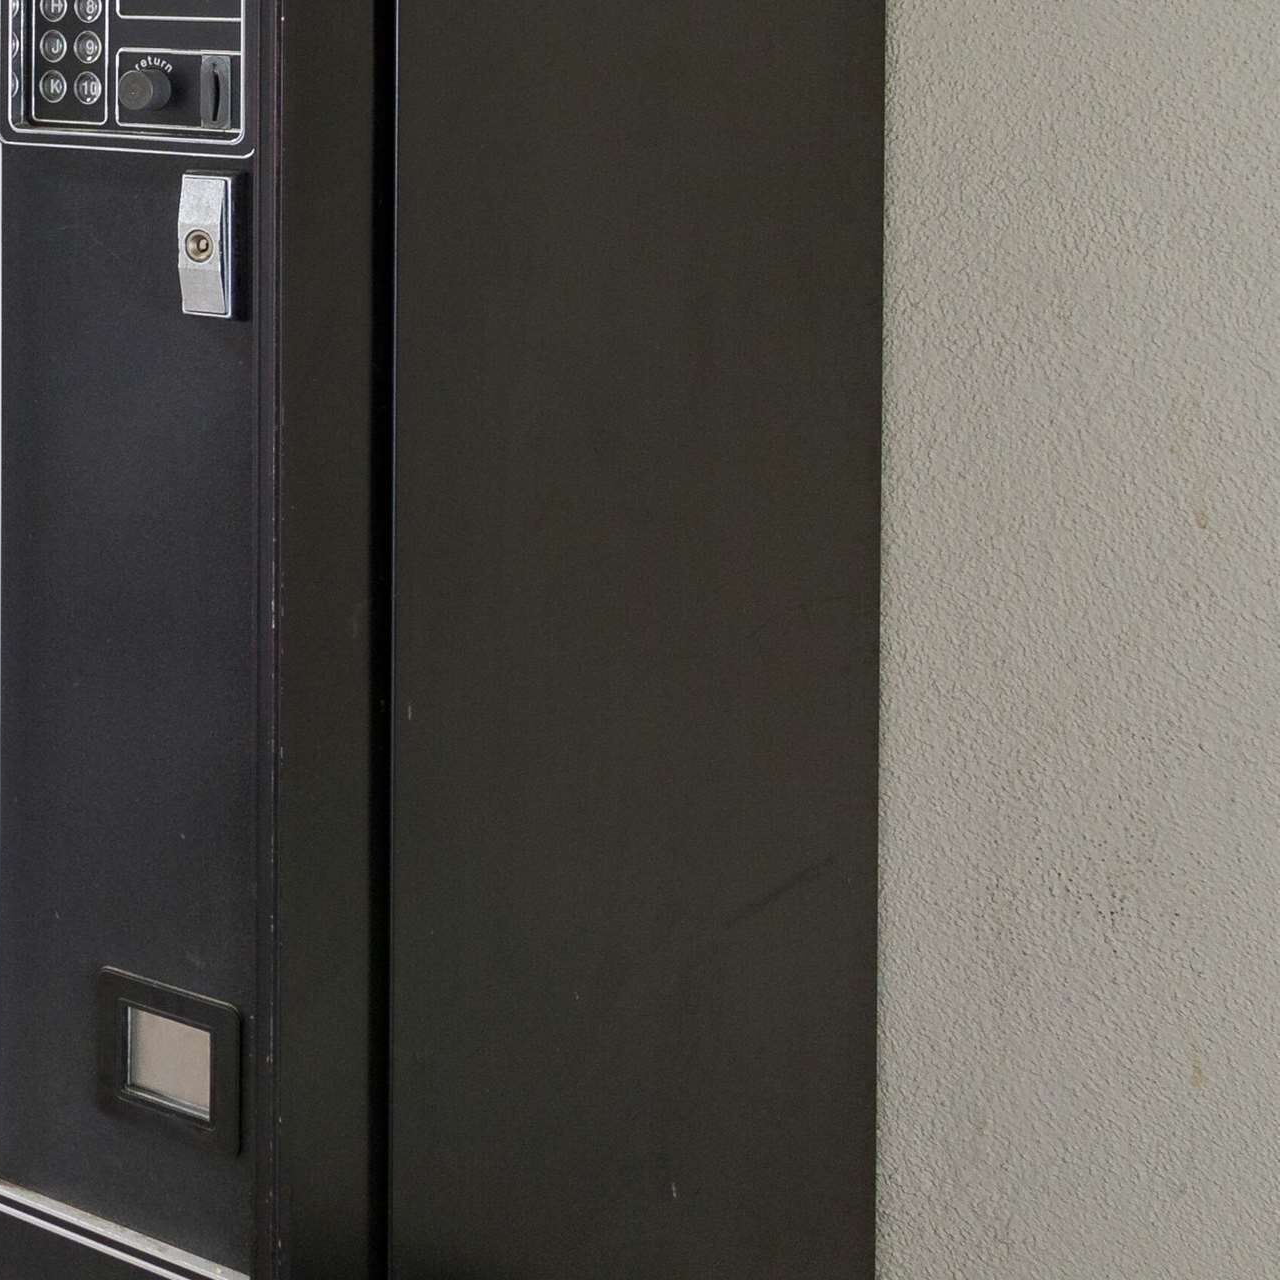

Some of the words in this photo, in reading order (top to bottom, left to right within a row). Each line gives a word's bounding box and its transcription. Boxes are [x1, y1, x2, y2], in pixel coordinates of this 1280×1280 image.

[51, 38, 61, 54] J
[85, 39, 95, 54] 9
[134, 55, 173, 73] return
[50, 78, 62, 93] K
[82, 80, 97, 95] 10
